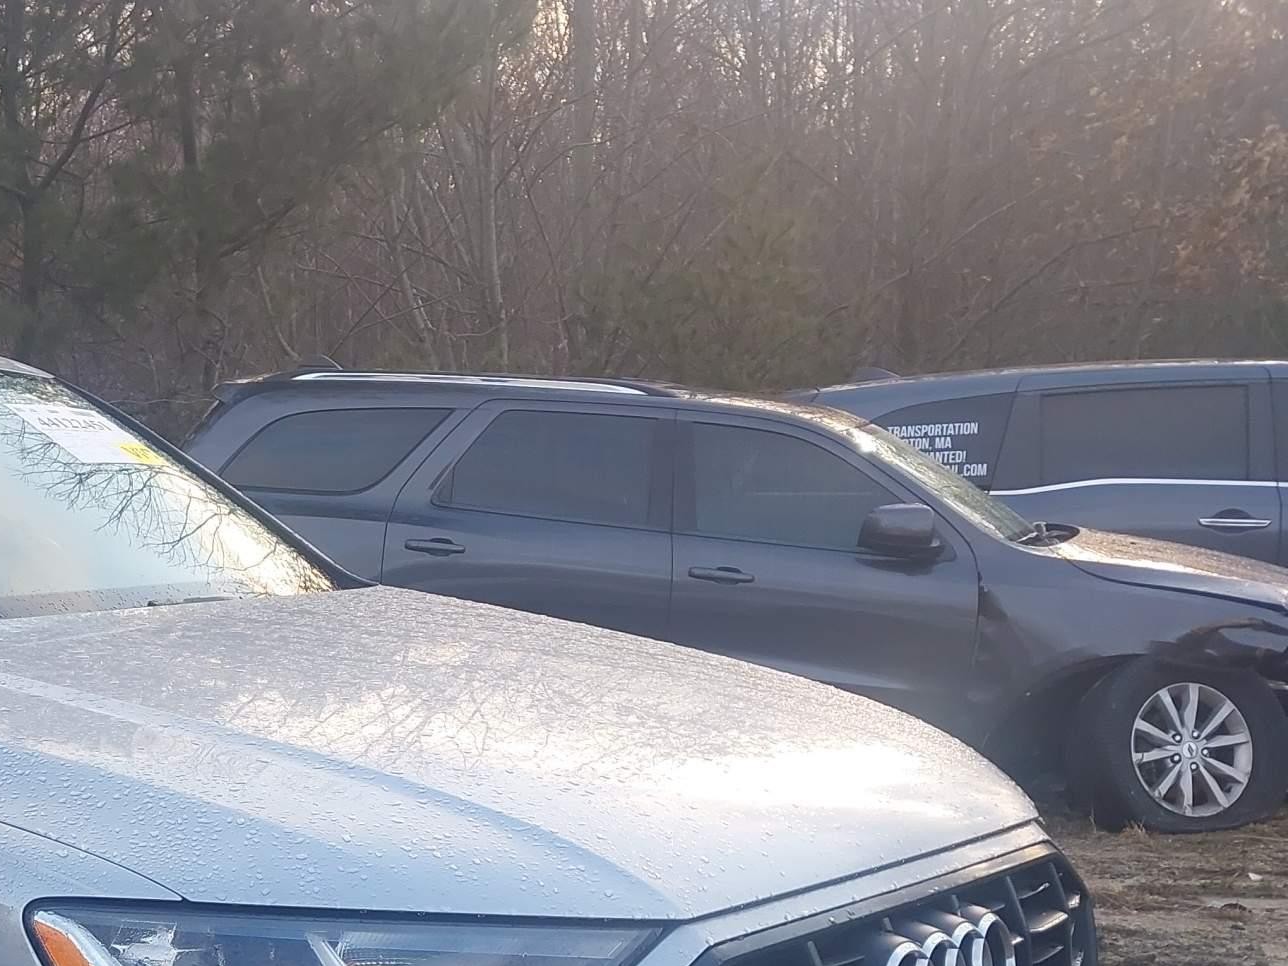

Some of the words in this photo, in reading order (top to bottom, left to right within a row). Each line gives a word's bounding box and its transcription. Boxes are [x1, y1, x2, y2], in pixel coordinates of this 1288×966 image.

[37, 417, 112, 431] 44122451
[888, 422, 979, 438] TRANSPORTATION
[935, 437, 952, 449] MA
[926, 451, 967, 464] ANTED!
